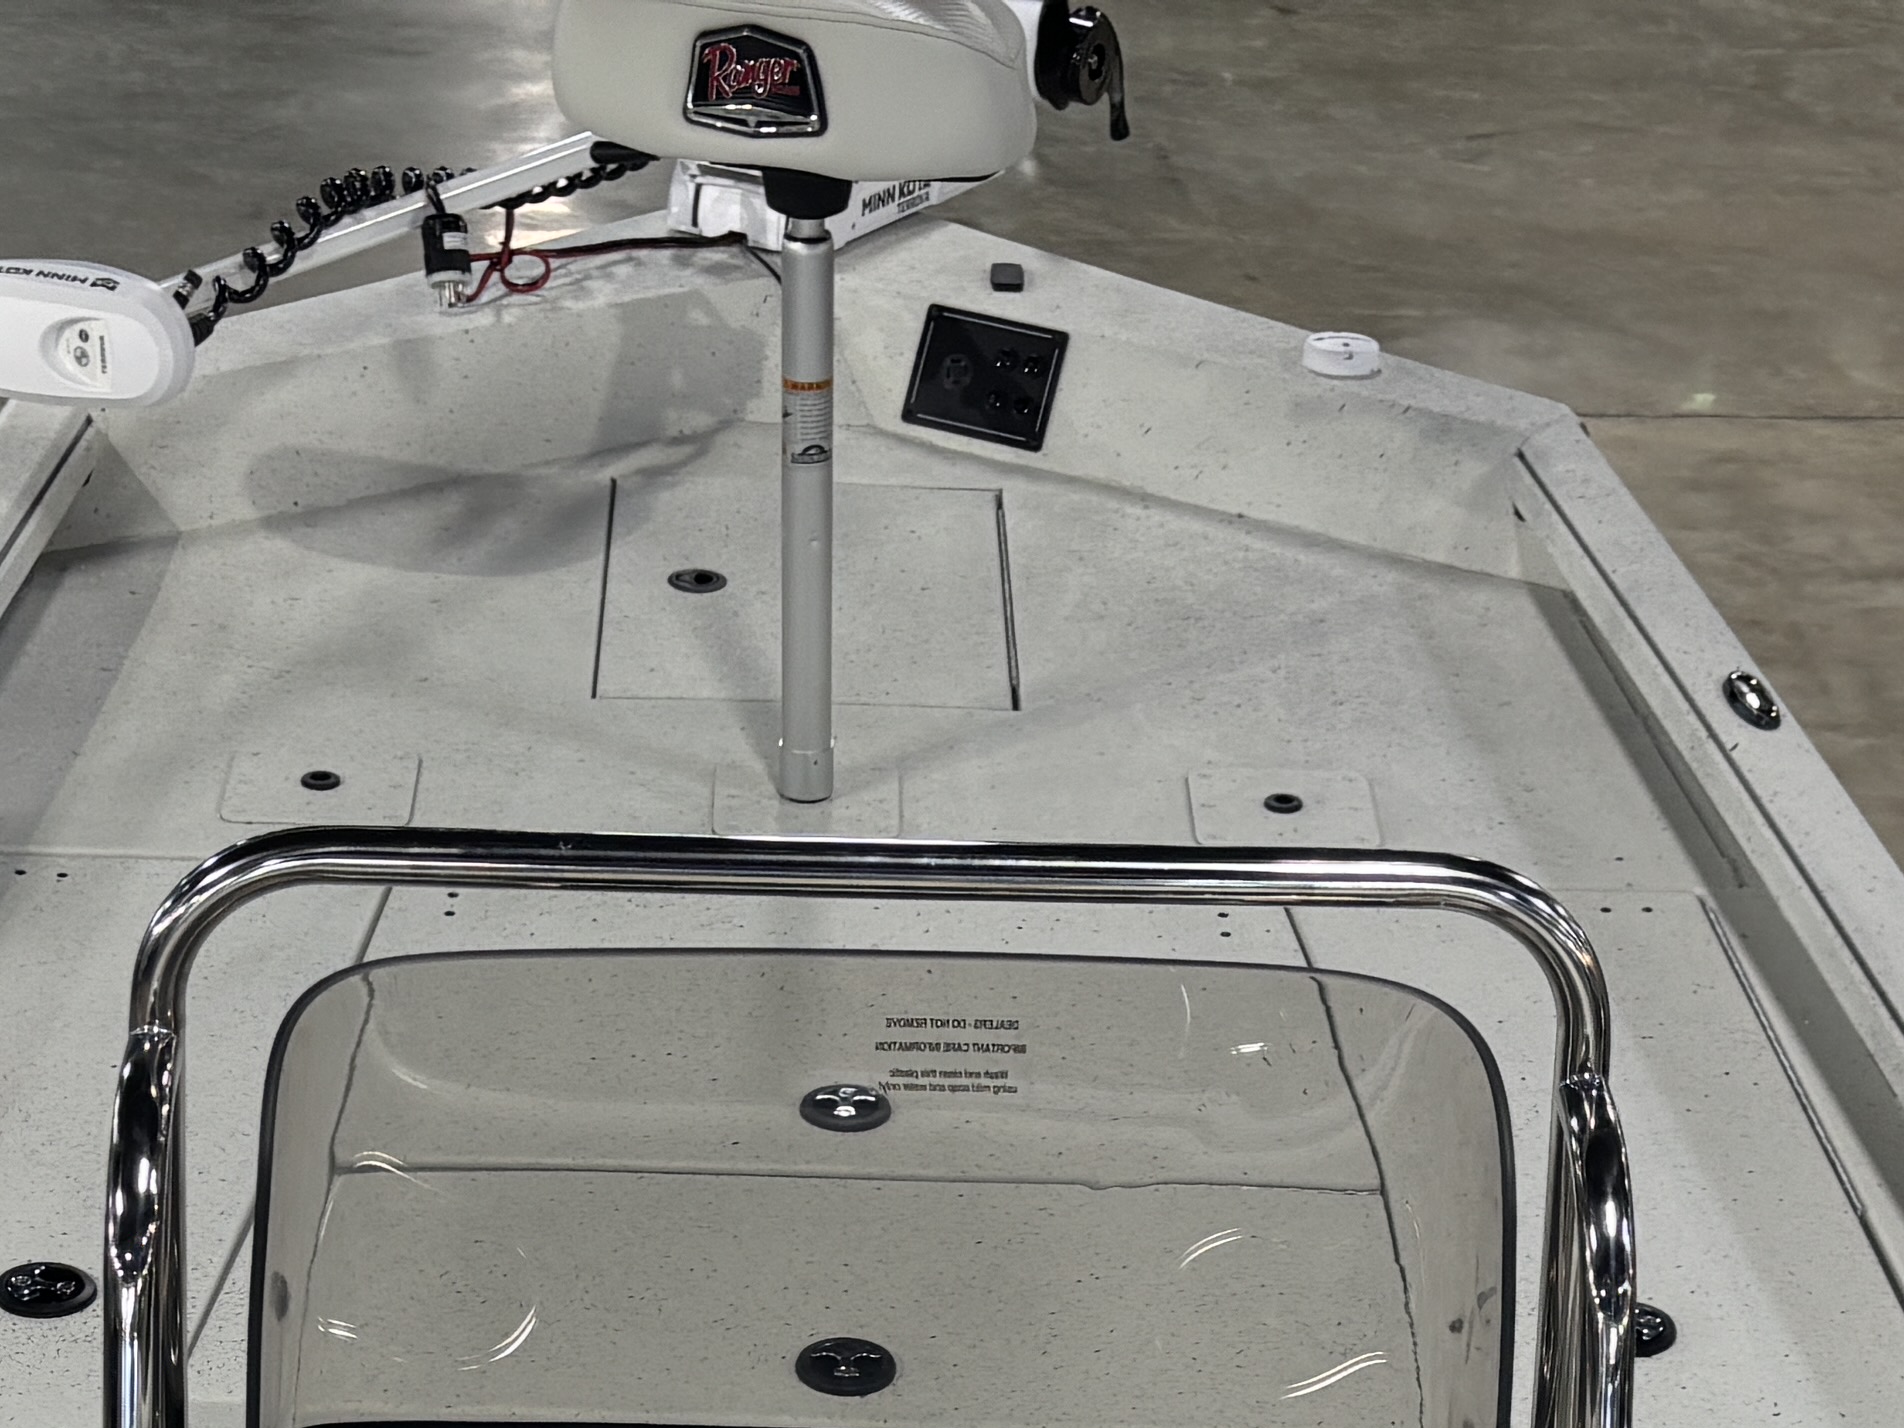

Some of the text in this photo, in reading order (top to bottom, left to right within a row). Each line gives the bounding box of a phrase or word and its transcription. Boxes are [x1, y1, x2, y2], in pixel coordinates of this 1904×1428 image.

[702, 42, 801, 100] Ranger
[861, 184, 896, 217] MINN
[34, 269, 89, 285] MINN
